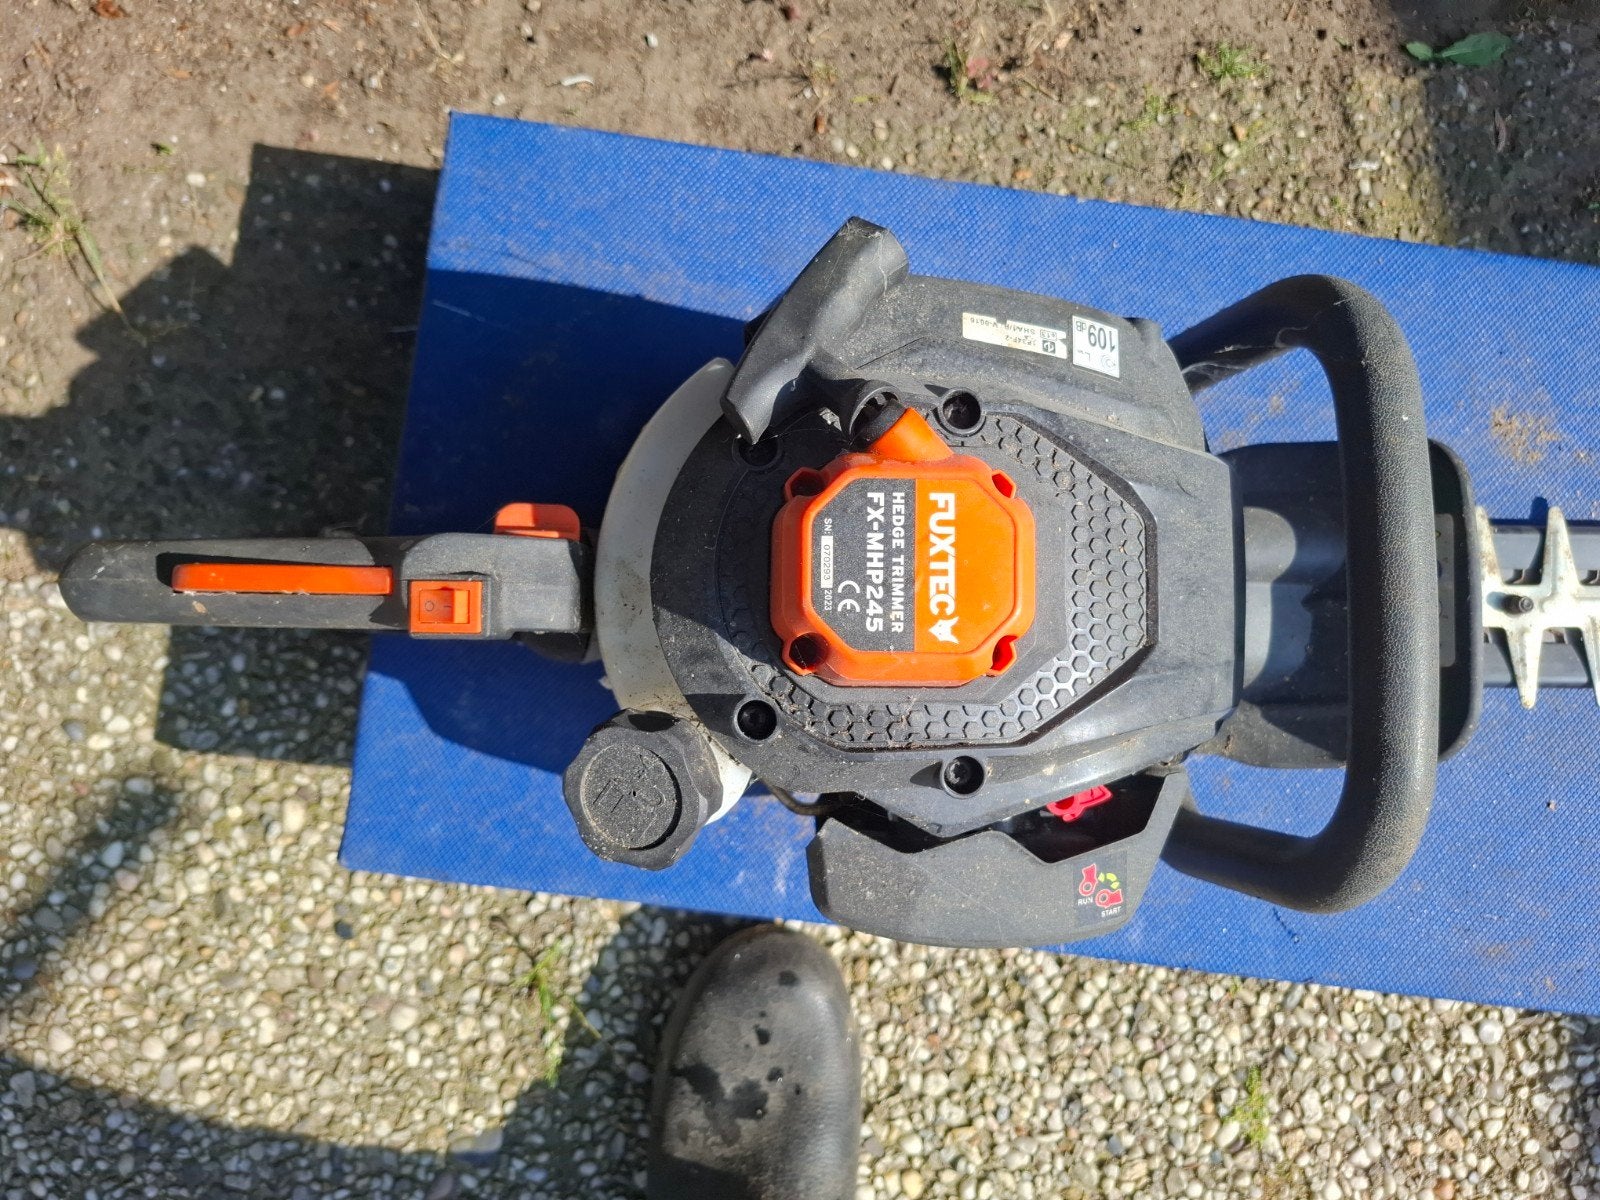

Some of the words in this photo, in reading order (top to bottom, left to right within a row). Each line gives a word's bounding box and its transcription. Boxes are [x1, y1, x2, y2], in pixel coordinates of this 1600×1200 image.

[1076, 320, 1087, 333] dB
[1088, 324, 1115, 353] 109
[824, 517, 832, 535] SN:
[891, 492, 905, 549] HEDGE
[822, 544, 831, 581] 070293
[865, 491, 885, 632] FX-MHP245
[928, 492, 956, 616] FUXTEC
[824, 589, 832, 611] 2023
[891, 554, 905, 633] TRIMMER
[1077, 896, 1094, 906] RUN
[1101, 906, 1121, 918] START
